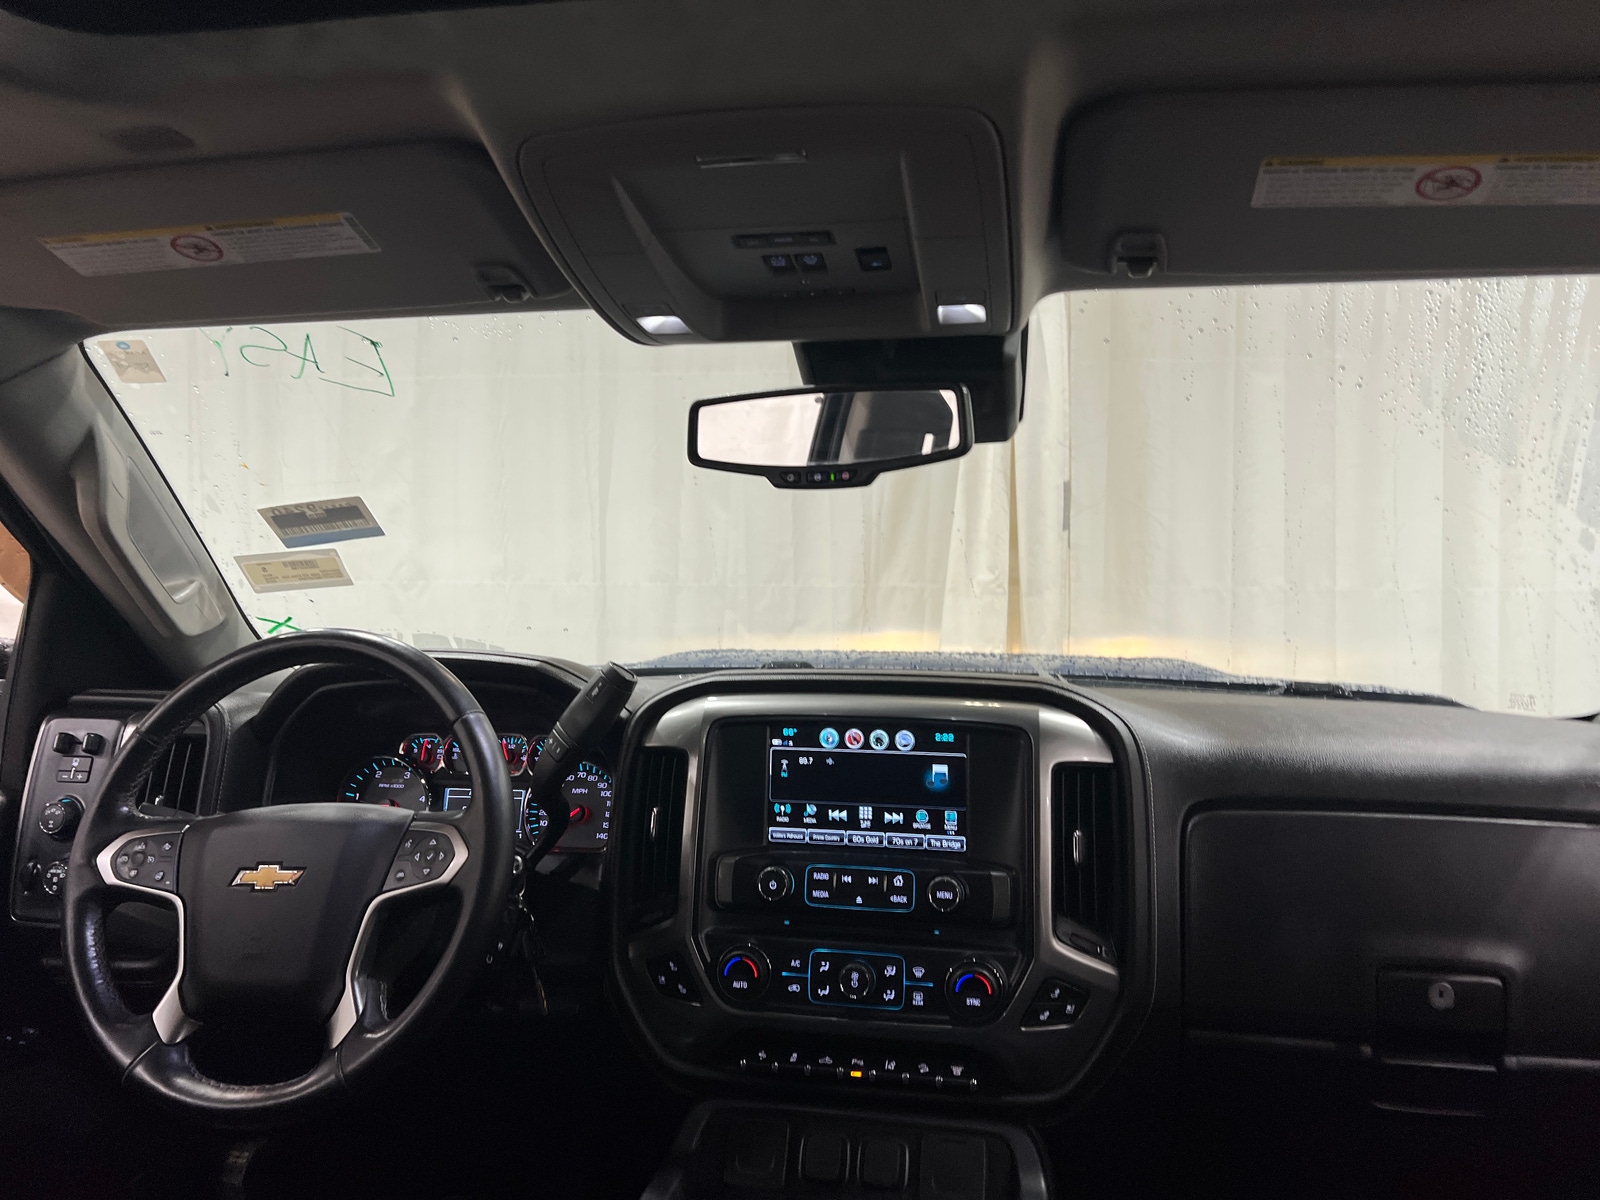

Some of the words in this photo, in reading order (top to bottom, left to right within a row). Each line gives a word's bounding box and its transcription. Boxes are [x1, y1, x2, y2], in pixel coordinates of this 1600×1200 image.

[375, 770, 383, 778] 2
[403, 771, 411, 779] 3
[355, 792, 360, 801] 1
[419, 795, 426, 803] 4
[892, 837, 904, 846] 70s
[930, 839, 942, 848] The
[942, 839, 961, 850] Bridge
[813, 872, 830, 881] RADIO
[812, 890, 830, 899] MEDIA
[936, 890, 953, 900] MENU
[892, 895, 908, 904] BACK
[790, 959, 801, 968] A/C
[732, 980, 748, 989] AUTO
